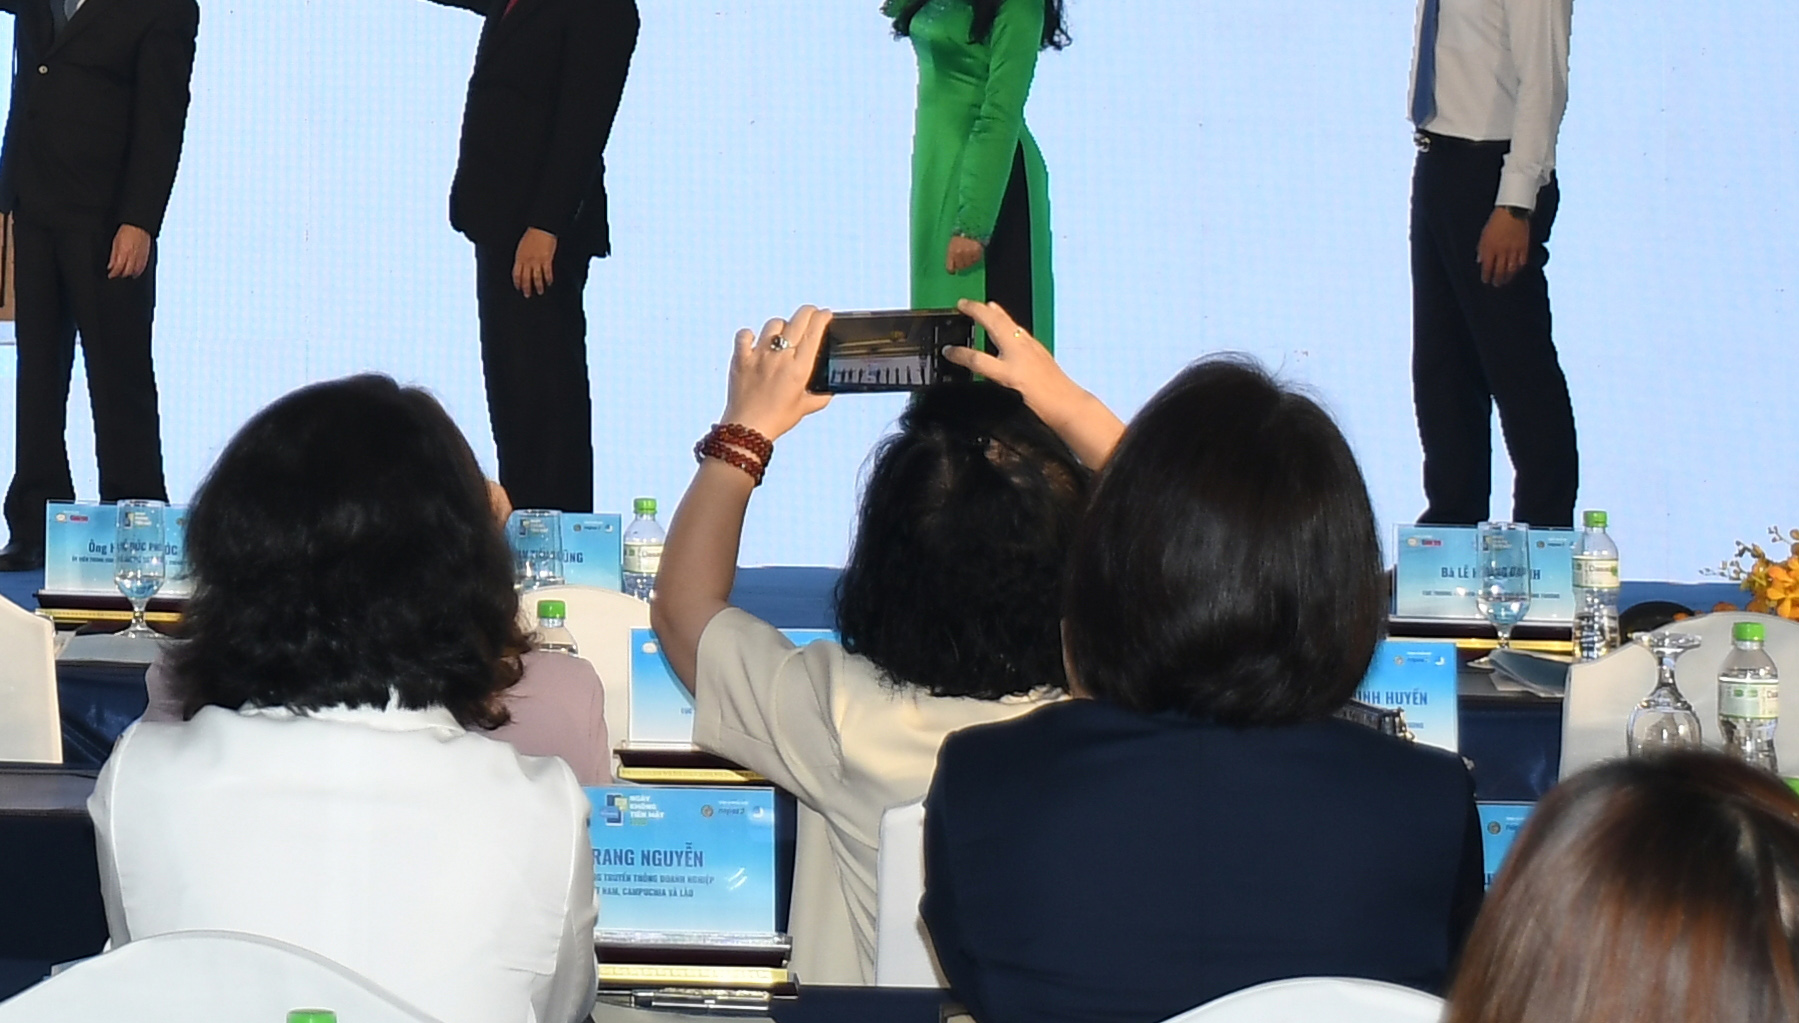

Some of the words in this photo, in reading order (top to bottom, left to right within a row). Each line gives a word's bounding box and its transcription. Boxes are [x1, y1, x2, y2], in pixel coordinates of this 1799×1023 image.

[88, 538, 107, 555] Ông
[591, 848, 635, 866] RANG
[640, 841, 704, 868] NGUYỄN
